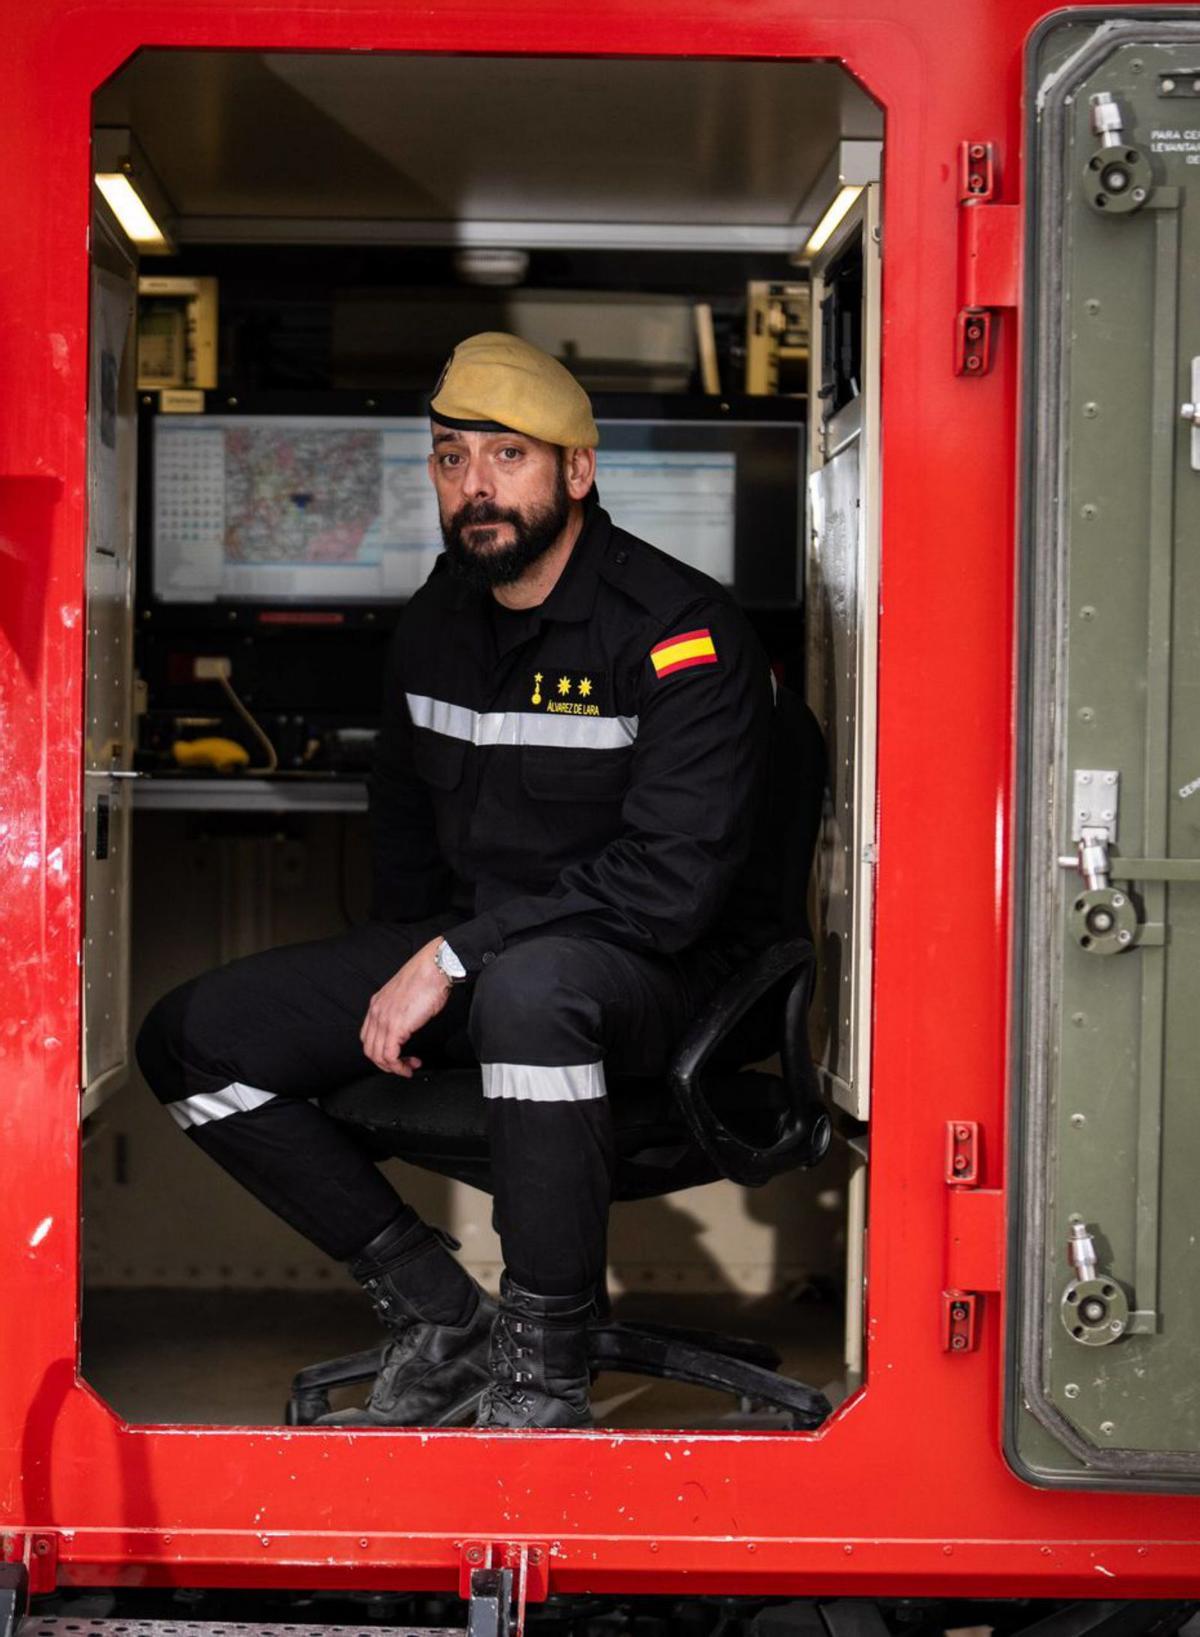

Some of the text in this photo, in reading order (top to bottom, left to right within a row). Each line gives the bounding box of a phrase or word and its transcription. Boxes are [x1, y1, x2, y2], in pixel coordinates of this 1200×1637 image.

[1151, 130, 1181, 140] PARA
[546, 699, 600, 716] ÁLVAREZ DE LARA
